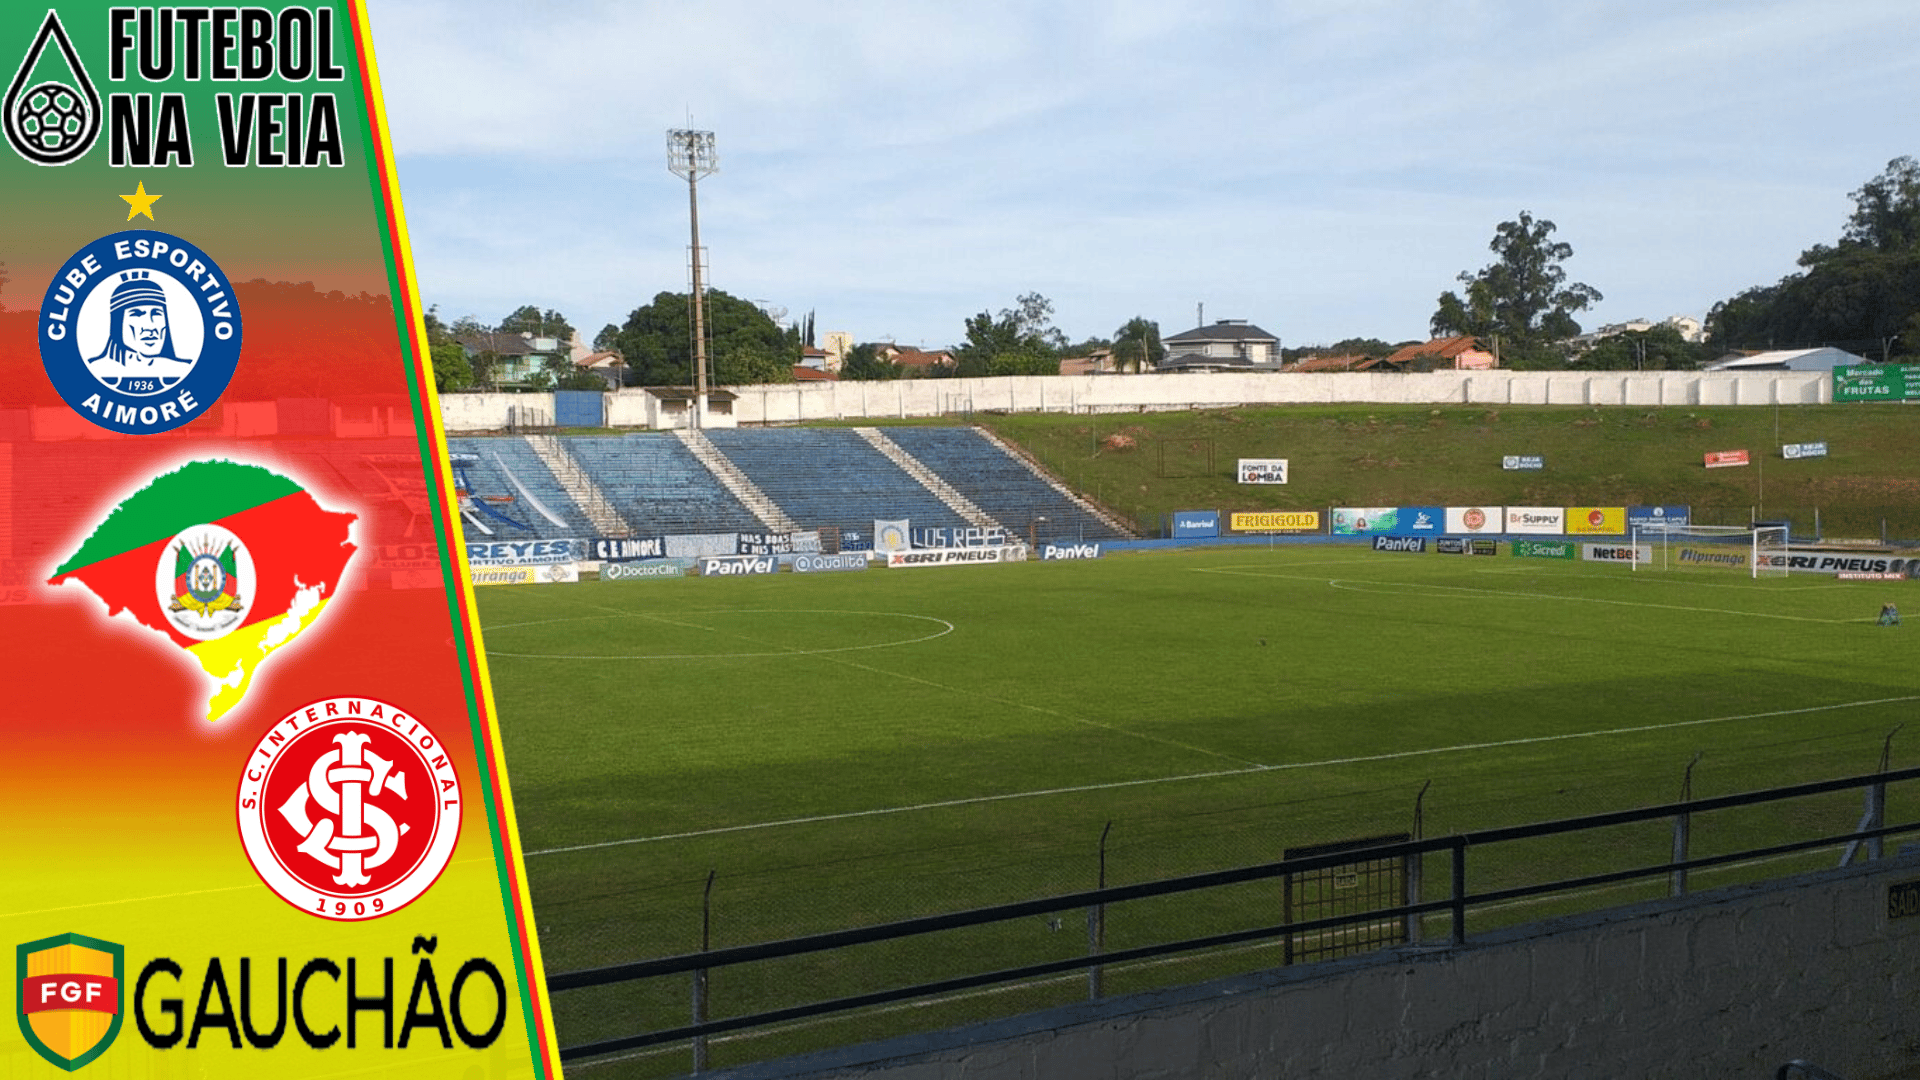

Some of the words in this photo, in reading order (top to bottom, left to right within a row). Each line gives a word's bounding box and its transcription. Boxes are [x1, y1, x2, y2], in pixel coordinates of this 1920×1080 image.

[1844, 385, 1890, 395] FRUTAS
[1242, 472, 1283, 482] LOMBA
[1236, 514, 1315, 527] FRIGIGOLD
[466, 540, 570, 559] REYES
[1376, 537, 1422, 551] PanVel
[945, 549, 998, 562] PNEUS
[1044, 544, 1099, 560] PanVel
[1593, 547, 1640, 561] NetBet
[622, 563, 679, 577] DoctorClin
[705, 556, 773, 575] PanVel
[1820, 557, 1888, 572] PNEUS
